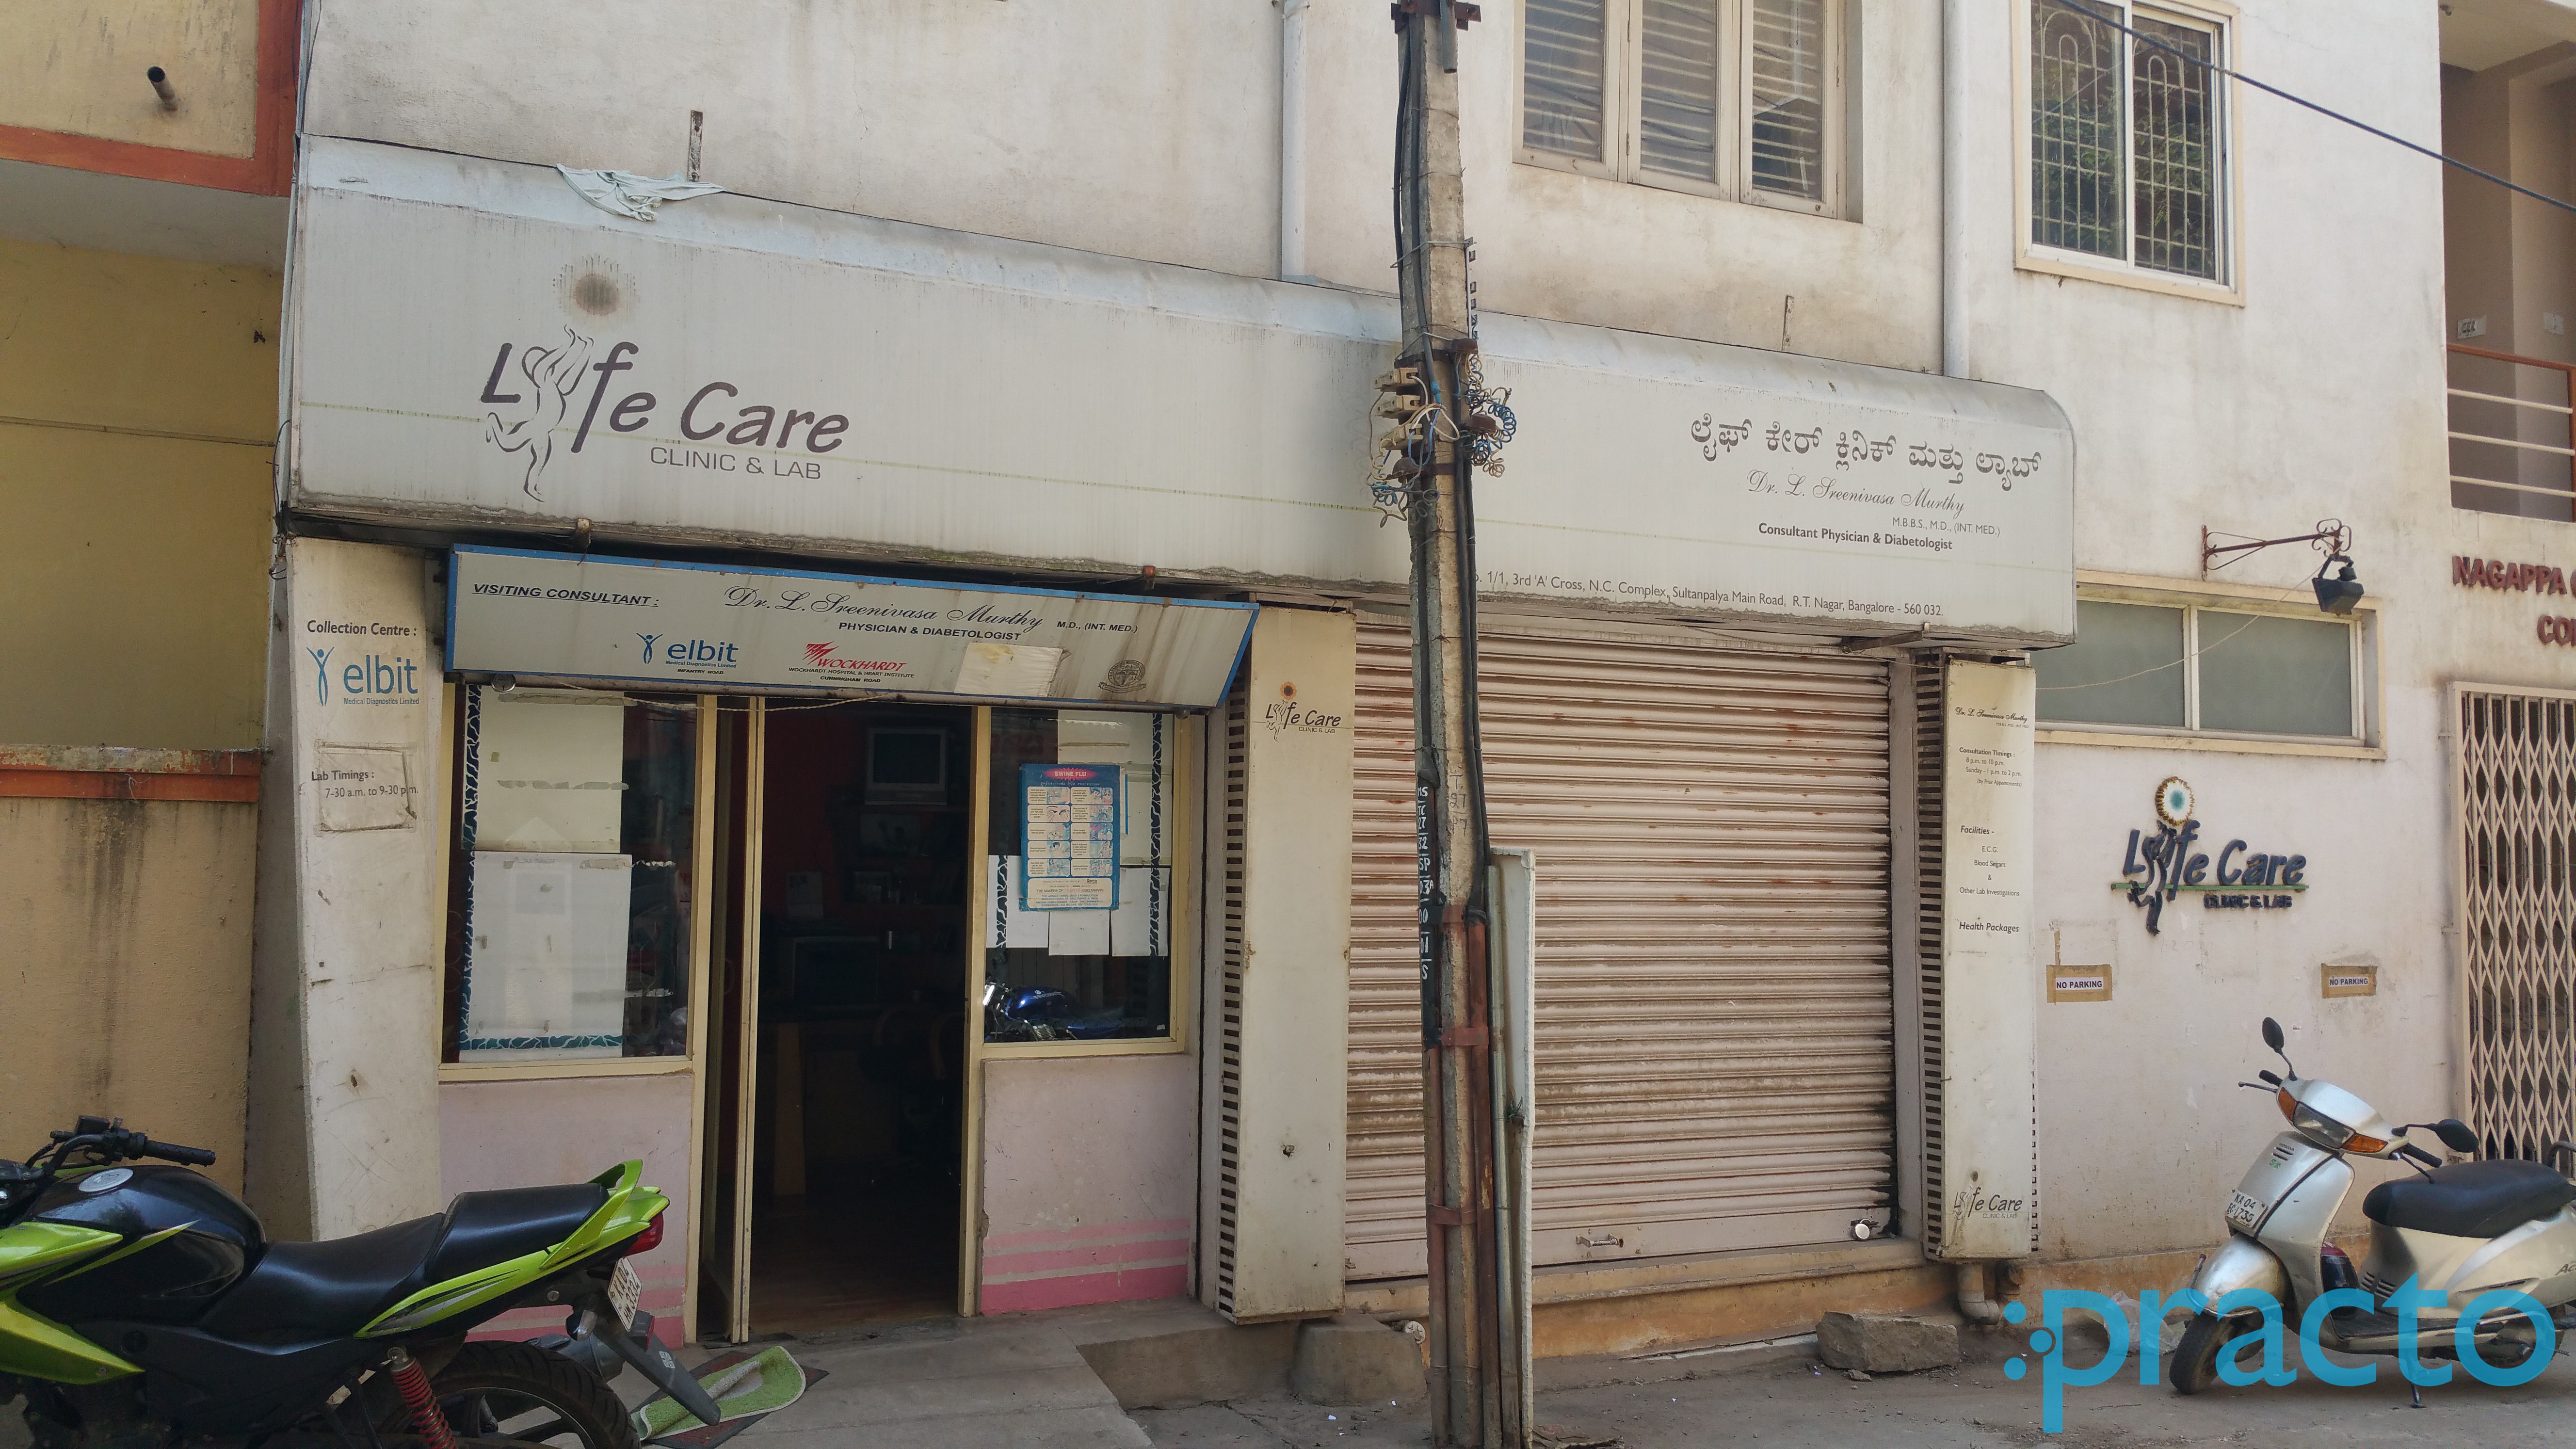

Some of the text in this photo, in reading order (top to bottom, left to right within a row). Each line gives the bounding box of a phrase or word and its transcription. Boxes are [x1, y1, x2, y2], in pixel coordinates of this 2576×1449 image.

[680, 381, 850, 453] Care
[1691, 413, 2042, 491] ಲೈಫ್ ಕೇರ್ ಕ್ಲಿನಿಕ್ ಮತ್ತು ಲ್ಯಾಬ್
[650, 447, 821, 481] CLINIC & LAB
[1746, 469, 1965, 519] Dr. L. Sreenivasa Murthy
[1758, 522, 1953, 551] Consultant Physician & Diabetologist
[1954, 522, 1973, 533] (INT.
[1975, 524, 2000, 537] MED.)
[2451, 556, 2568, 595] NAGAPPA
[472, 583, 651, 606] VISITING CONSULTANT
[1487, 570, 1944, 616] 1/1, 3rd 'A' Cross, N.C. Complex, Sultanpalya Main Road, R.T. Nagar, Bangalore 560 032.
[724, 585, 1139, 634] Dr. L. Sreenivasa Murthy M.D., (INT. MED.)
[306, 620, 367, 635] Collection
[370, 622, 411, 636] Centre
[838, 622, 1022, 642] PHYSICIAN & DIABETOLOGIST
[667, 639, 739, 663] elbit
[817, 658, 907, 672] WOCKHARDT
[343, 655, 419, 694] elbit
[367, 697, 398, 707] Diagnostics
[1305, 709, 1341, 727] Care
[1955, 707, 1965, 716] Dr.
[1976, 709, 2004, 719] Sreenivasa
[2005, 712, 2028, 724] Murthy
[1959, 747, 2012, 758] Consultation Timings
[311, 770, 369, 783] Lab Timings
[1965, 766, 1982, 774] Sunday
[325, 788, 345, 798] 7-30
[347, 789, 366, 797] a.m.
[368, 787, 377, 797] to
[379, 786, 399, 796] 9-30
[1961, 825, 1990, 835] Facilities
[1418, 836, 1428, 850] 32
[1419, 857, 1431, 871] SP
[2217, 838, 2307, 886] Care
[1987, 888, 2020, 897] Investigations
[2263, 895, 2292, 908] LAB
[1959, 921, 2019, 934] Health Packages
[1422, 964, 1428, 980] S
[1988, 1194, 2023, 1211] Care
